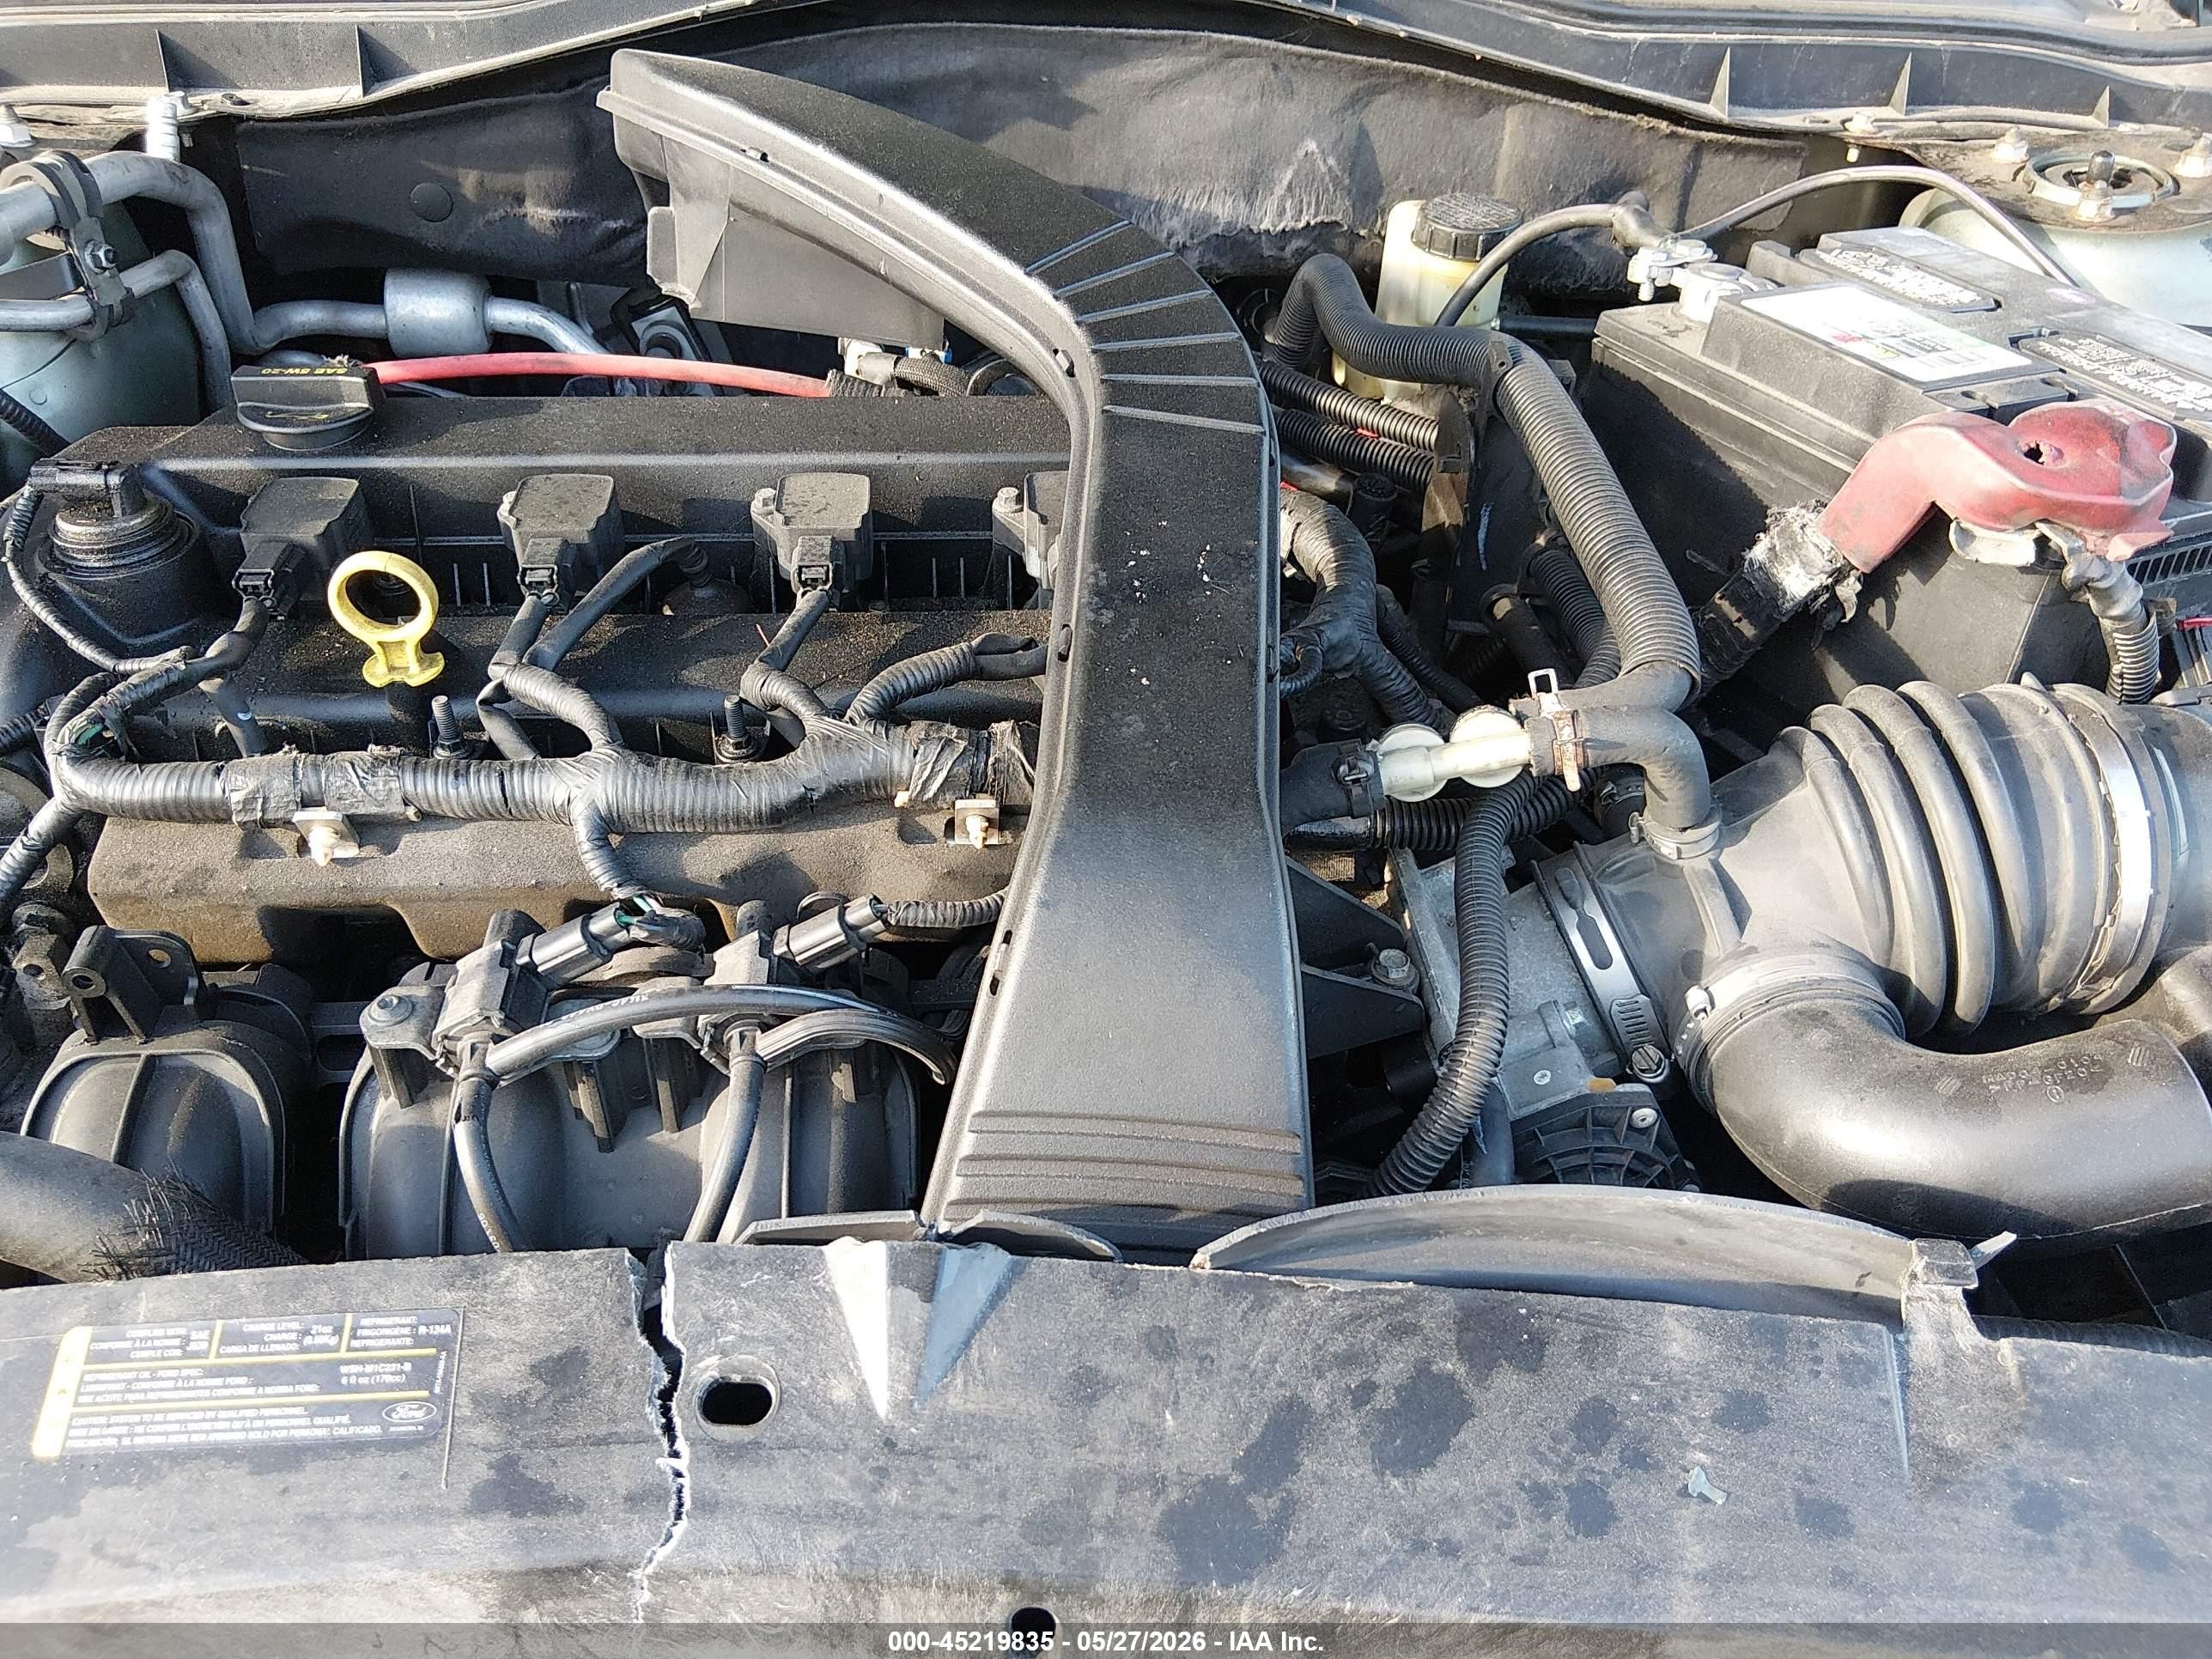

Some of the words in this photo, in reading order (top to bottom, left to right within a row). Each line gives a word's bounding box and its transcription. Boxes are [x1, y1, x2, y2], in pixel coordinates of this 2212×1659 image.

[360, 1316, 419, 1327] REFRIGERANT:
[242, 1323, 276, 1333] CHARGE
[276, 1322, 305, 1331] LEVEL:
[417, 1324, 453, 1335] R-134A
[263, 1333, 298, 1342] CHARGE
[219, 1346, 248, 1354] CARGA
[247, 1345, 260, 1353] DE
[259, 1343, 301, 1352] LLENADO:
[340, 1376, 349, 1385] 6
[349, 1375, 357, 1384] fl
[357, 1376, 371, 1385] oz
[391, 1405, 428, 1419] Ford
[141, 1414, 154, 1424] TO
[270, 1429, 289, 1438] POR
[331, 1425, 383, 1436] CALIFICADO.
